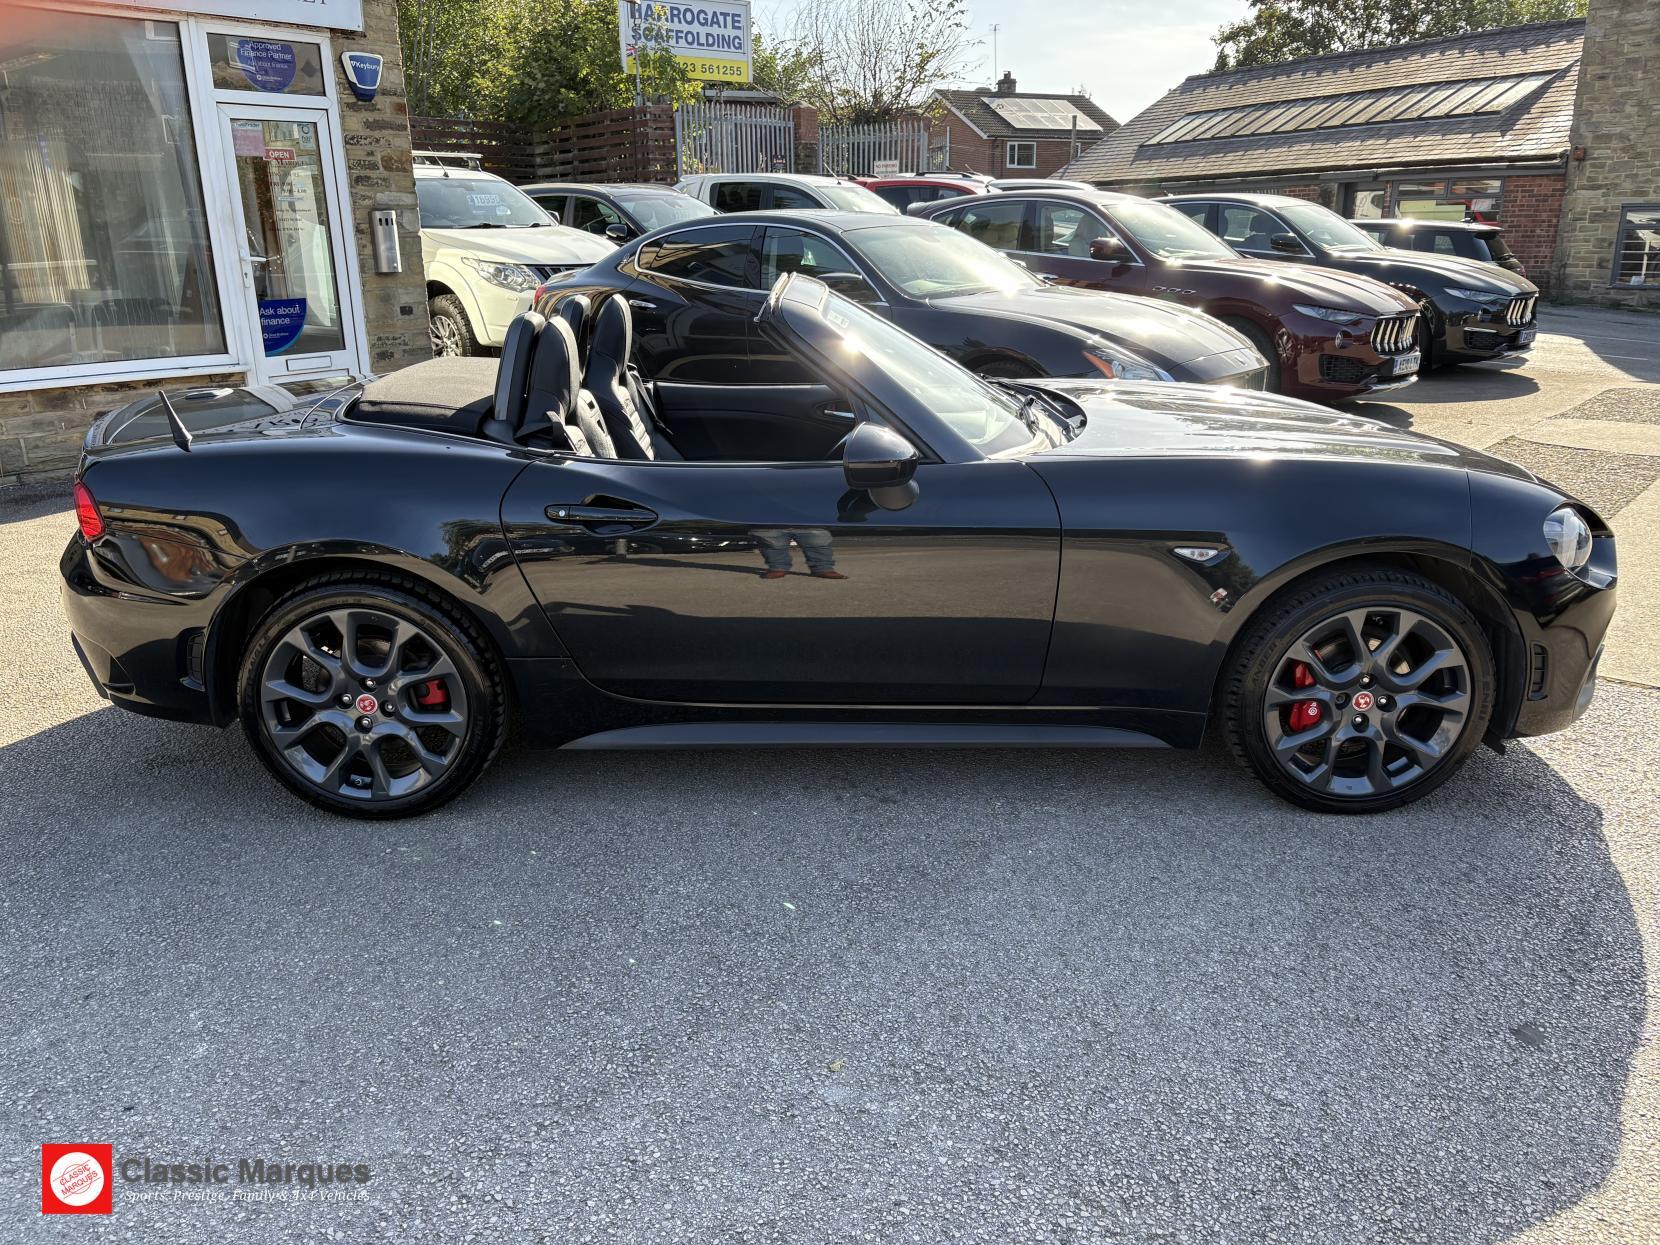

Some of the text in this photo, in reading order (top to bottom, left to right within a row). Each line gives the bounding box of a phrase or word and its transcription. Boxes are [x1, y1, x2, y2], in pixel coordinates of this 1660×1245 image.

[631, 25, 743, 50] SCAFFOLDING
[249, 41, 282, 51] Approved
[240, 49, 292, 60] Finance Partner
[355, 61, 380, 71] Keybury
[700, 63, 742, 76] 561255
[269, 151, 290, 159] OPEN
[260, 304, 301, 316] Ask about
[261, 317, 290, 326] finance
